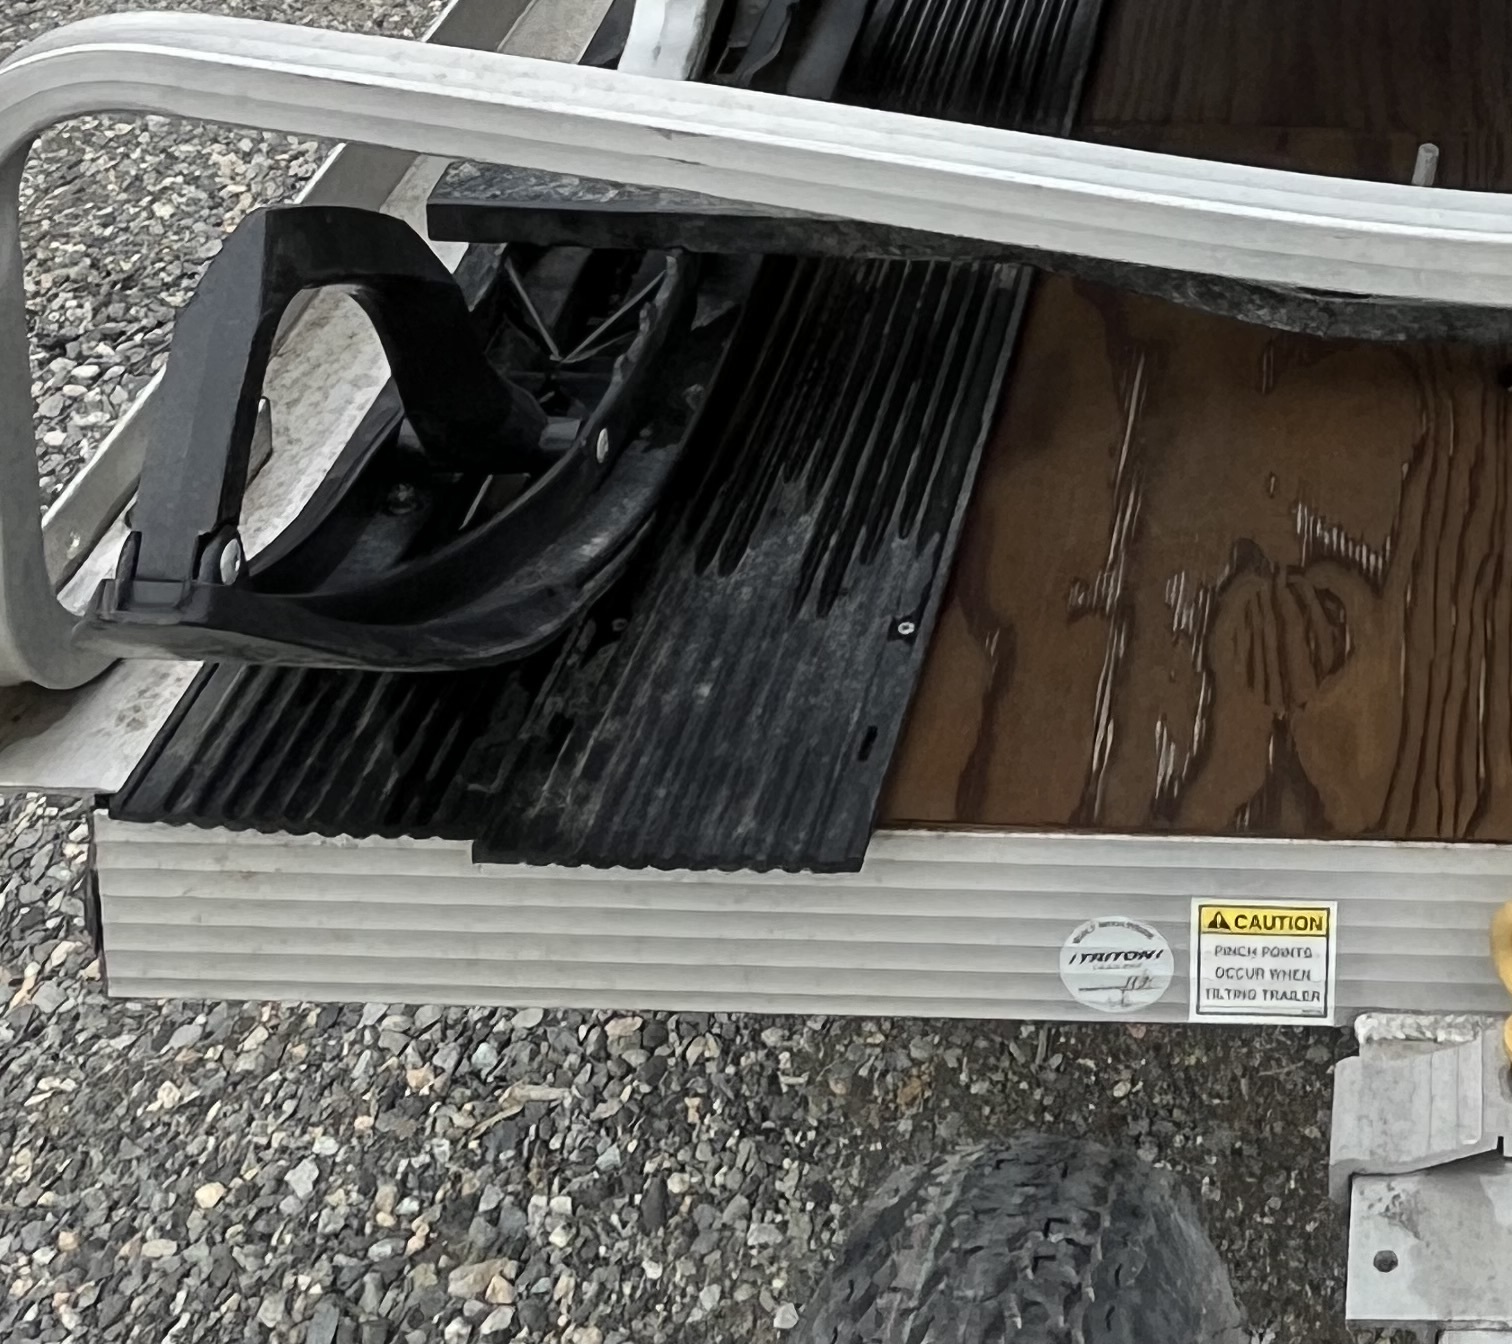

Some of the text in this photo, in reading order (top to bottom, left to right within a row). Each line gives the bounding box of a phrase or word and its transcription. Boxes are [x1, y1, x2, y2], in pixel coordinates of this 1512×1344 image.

[1235, 914, 1323, 931] CAUTION
[1215, 945, 1312, 959] PINCH POINTS
[1215, 967, 1311, 981] OCCUR WHEN
[1262, 989, 1320, 1002] TRAILER
